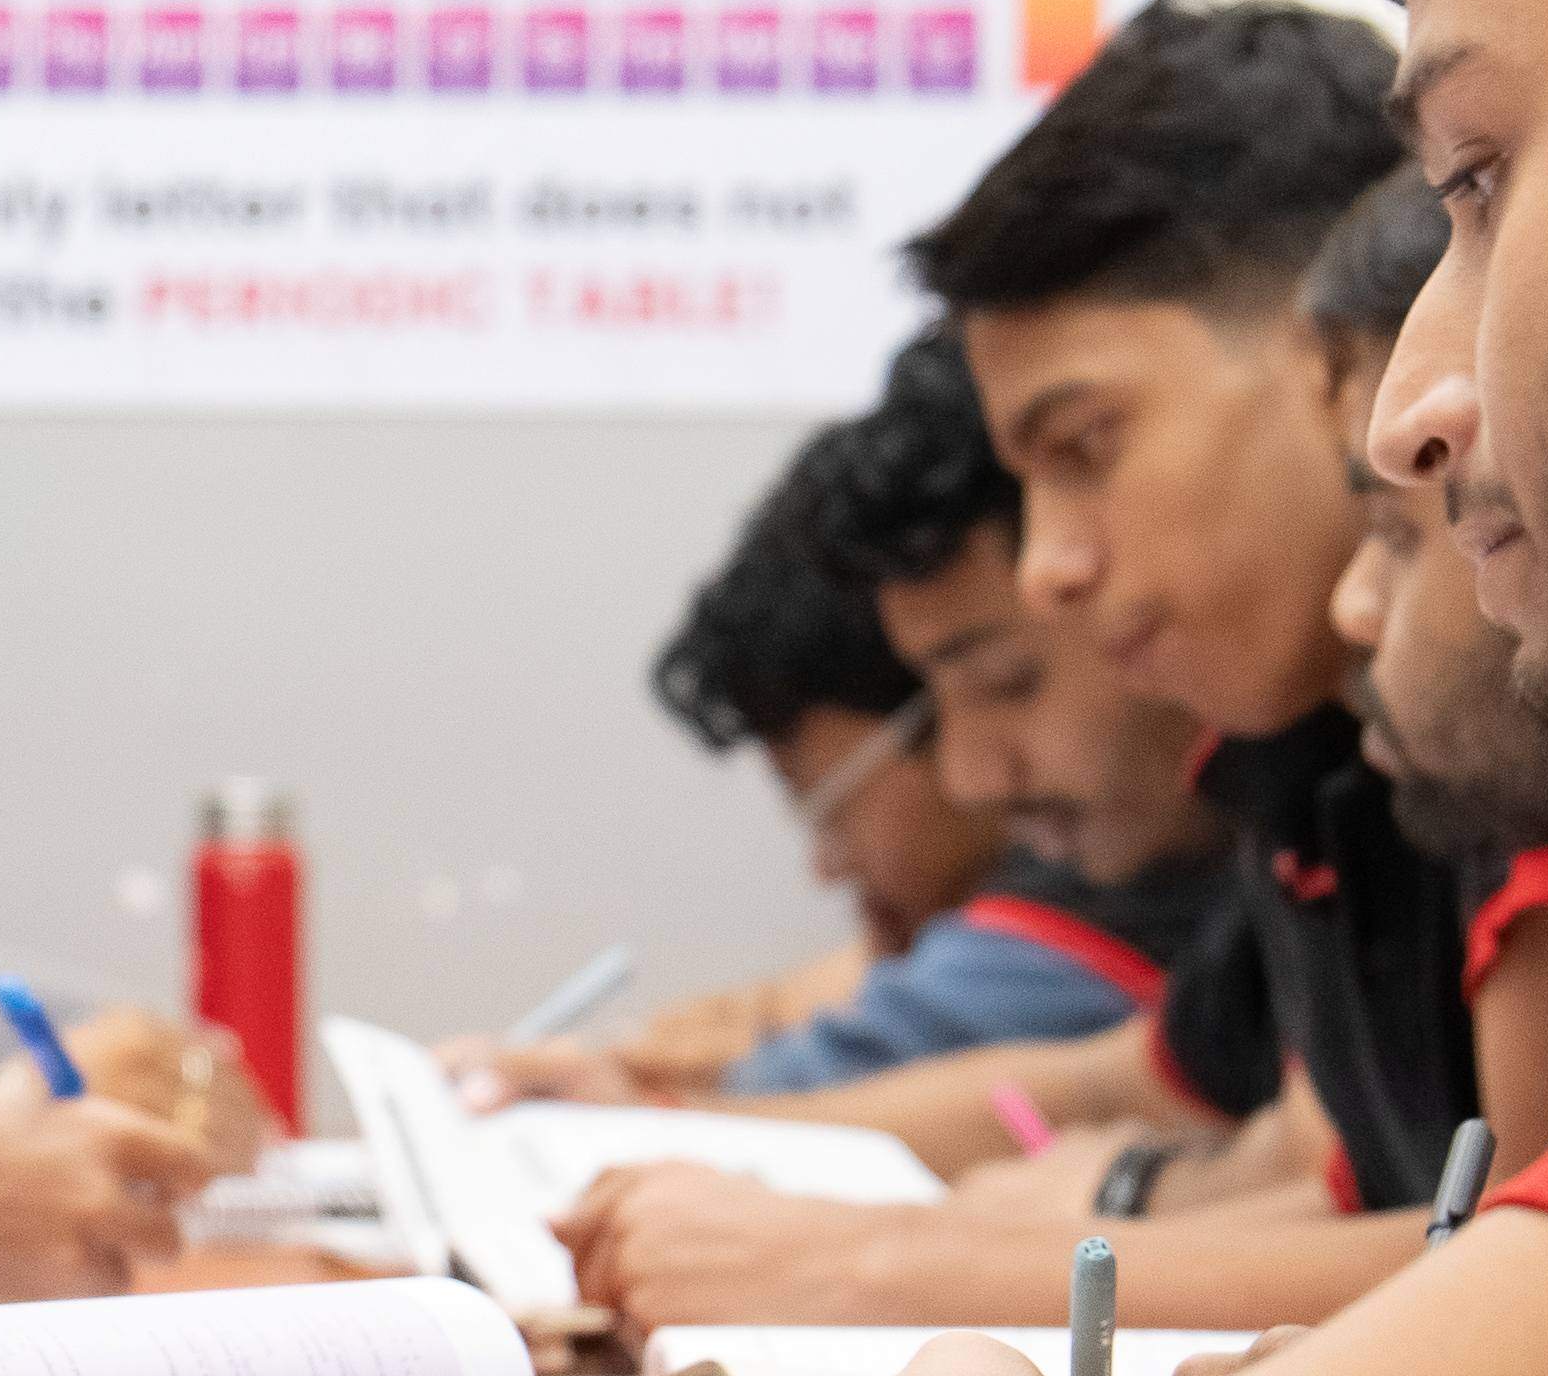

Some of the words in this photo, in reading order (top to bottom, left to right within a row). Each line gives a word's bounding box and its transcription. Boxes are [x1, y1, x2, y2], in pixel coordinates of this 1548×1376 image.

[100, 173, 304, 228] letter
[332, 173, 490, 228] that
[518, 173, 700, 228] does
[730, 173, 856, 228] not
[138, 272, 494, 326] PERIODIC
